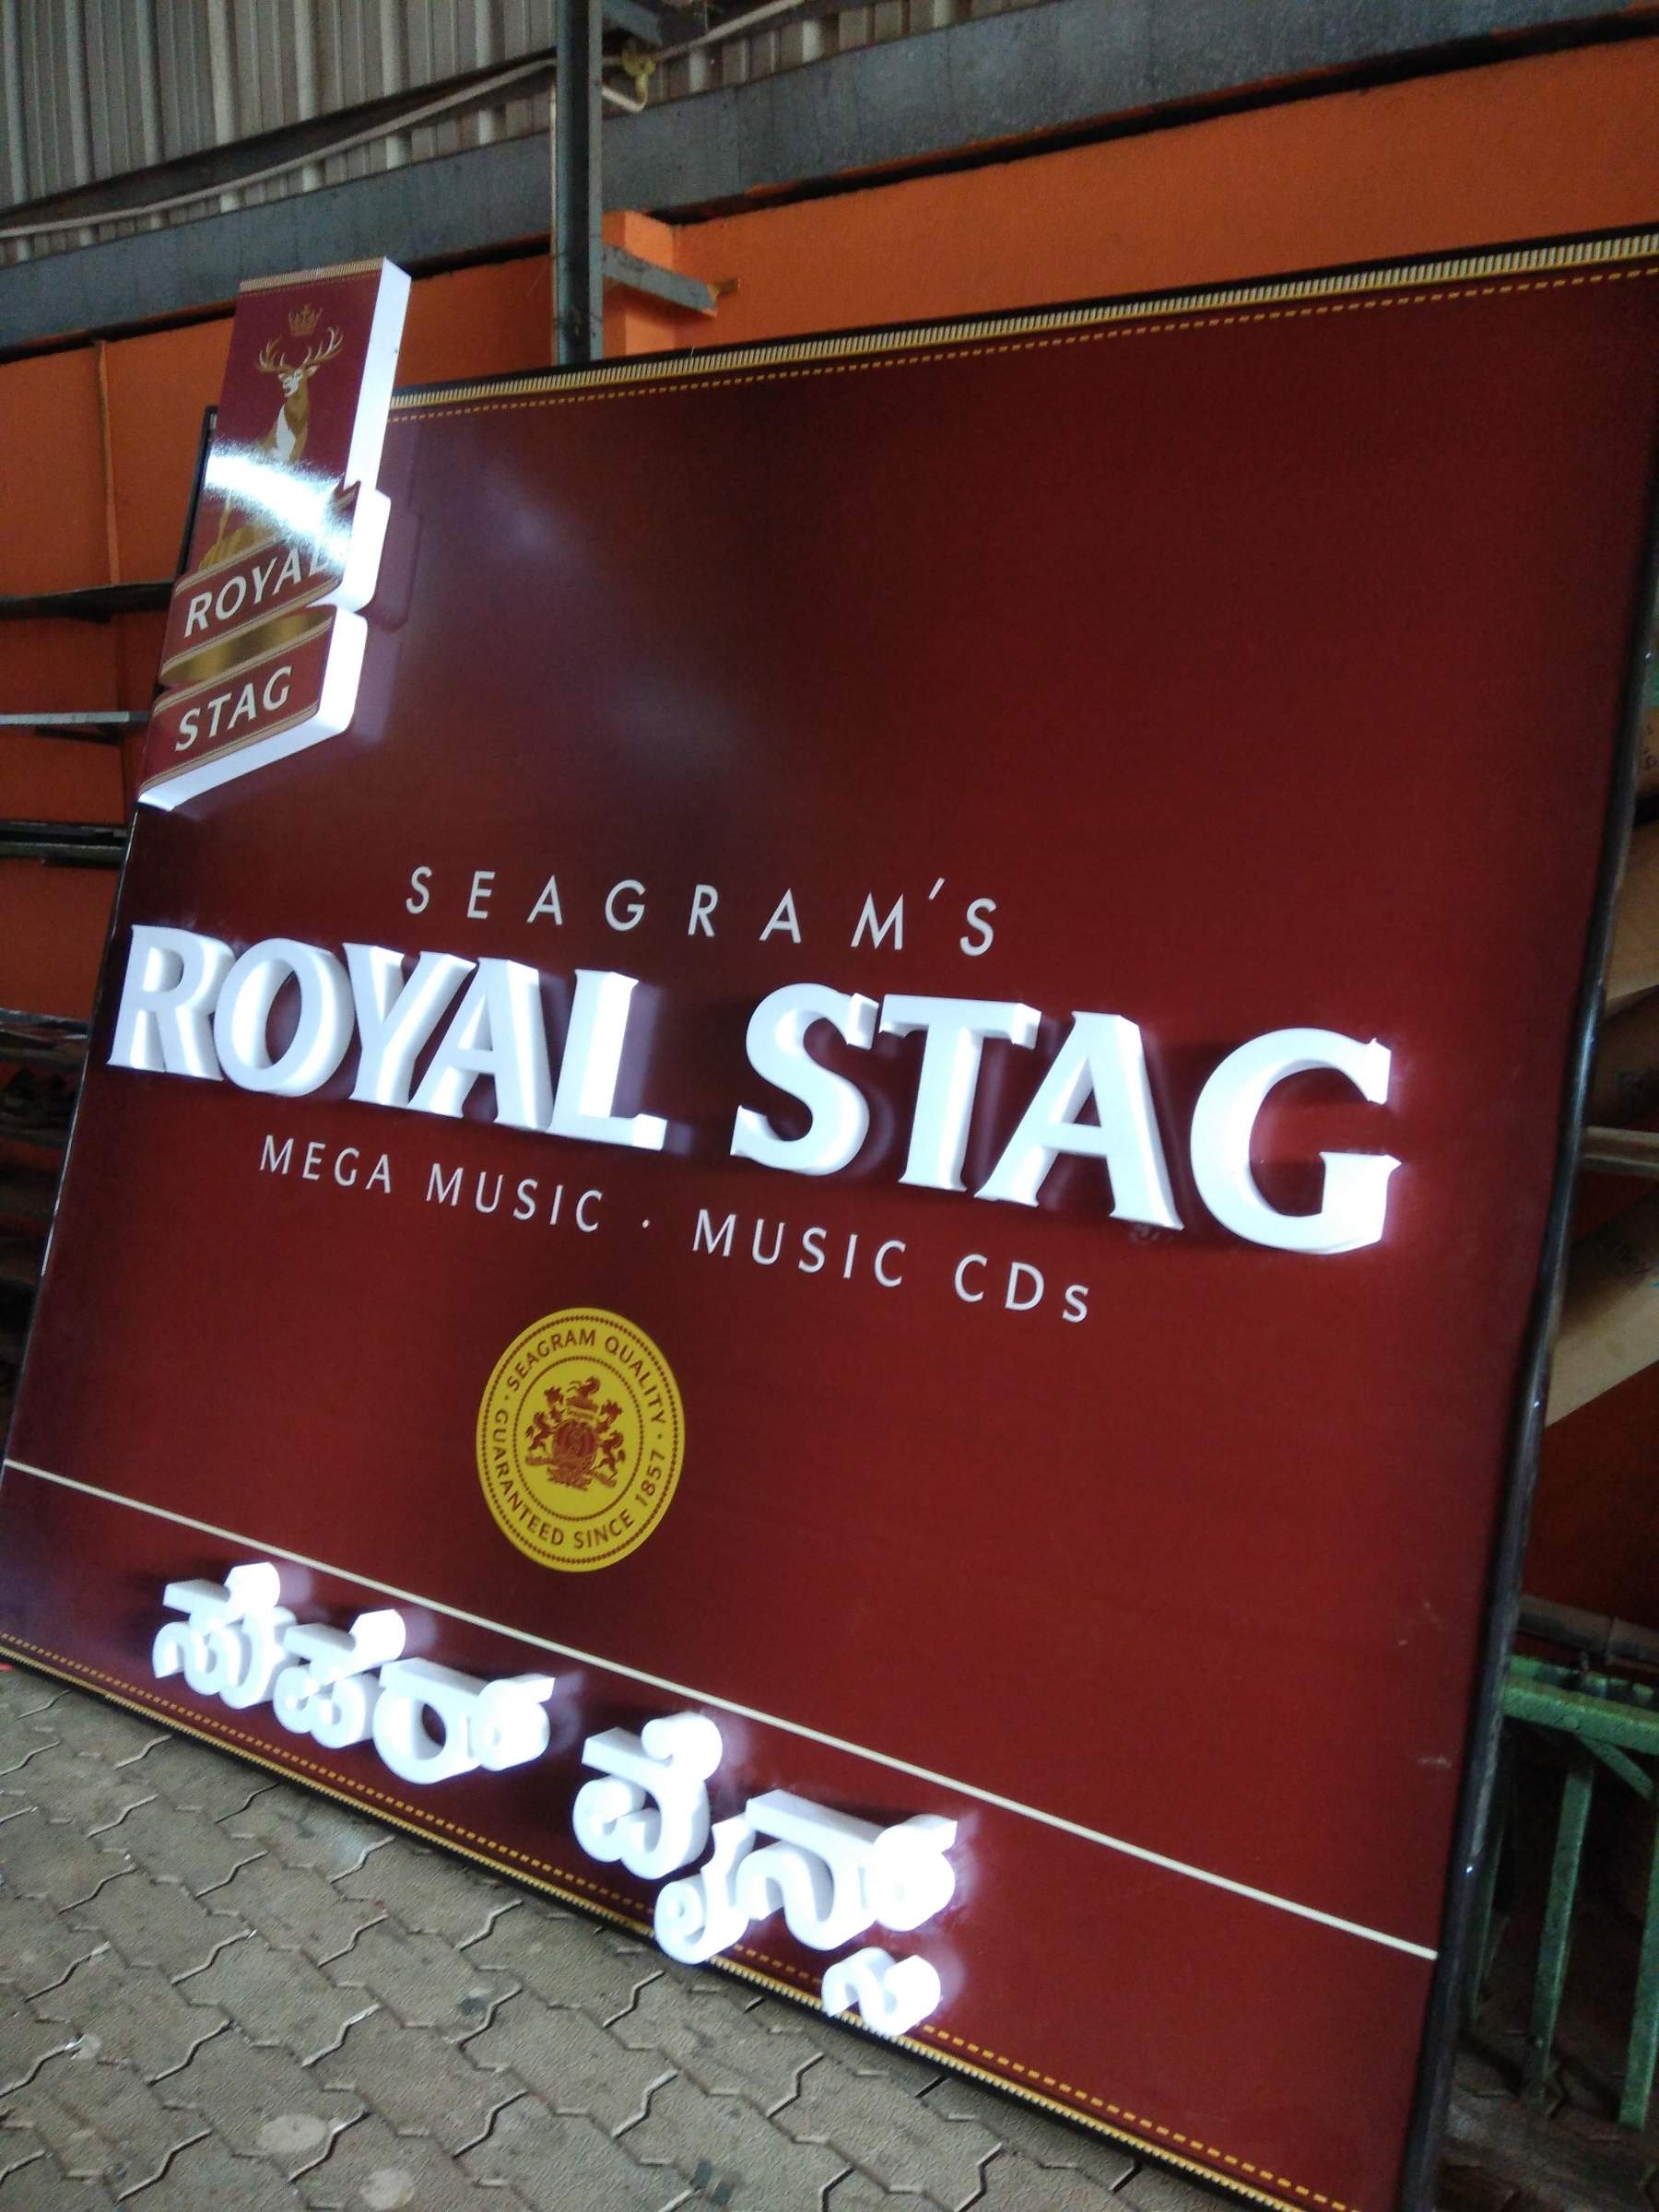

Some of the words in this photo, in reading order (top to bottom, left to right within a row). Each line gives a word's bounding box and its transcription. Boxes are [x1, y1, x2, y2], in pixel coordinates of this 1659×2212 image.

[174, 665, 293, 752] STAG
[406, 865, 998, 957] SEAGRAM'S
[107, 924, 667, 1150] ROYAL
[730, 982, 1402, 1254] STAG
[259, 1135, 392, 1194] MEGA
[427, 1163, 602, 1232] MUSIC
[692, 1209, 906, 1288] MUSIC
[955, 1254, 1090, 1323] CDs
[507, 1328, 595, 1392] SEAGRAM
[605, 1335, 665, 1425] QUALITY
[492, 1407, 564, 1547] GUARANTEED
[573, 1508, 635, 1549] SINCE
[634, 1449, 665, 1506] 1857
